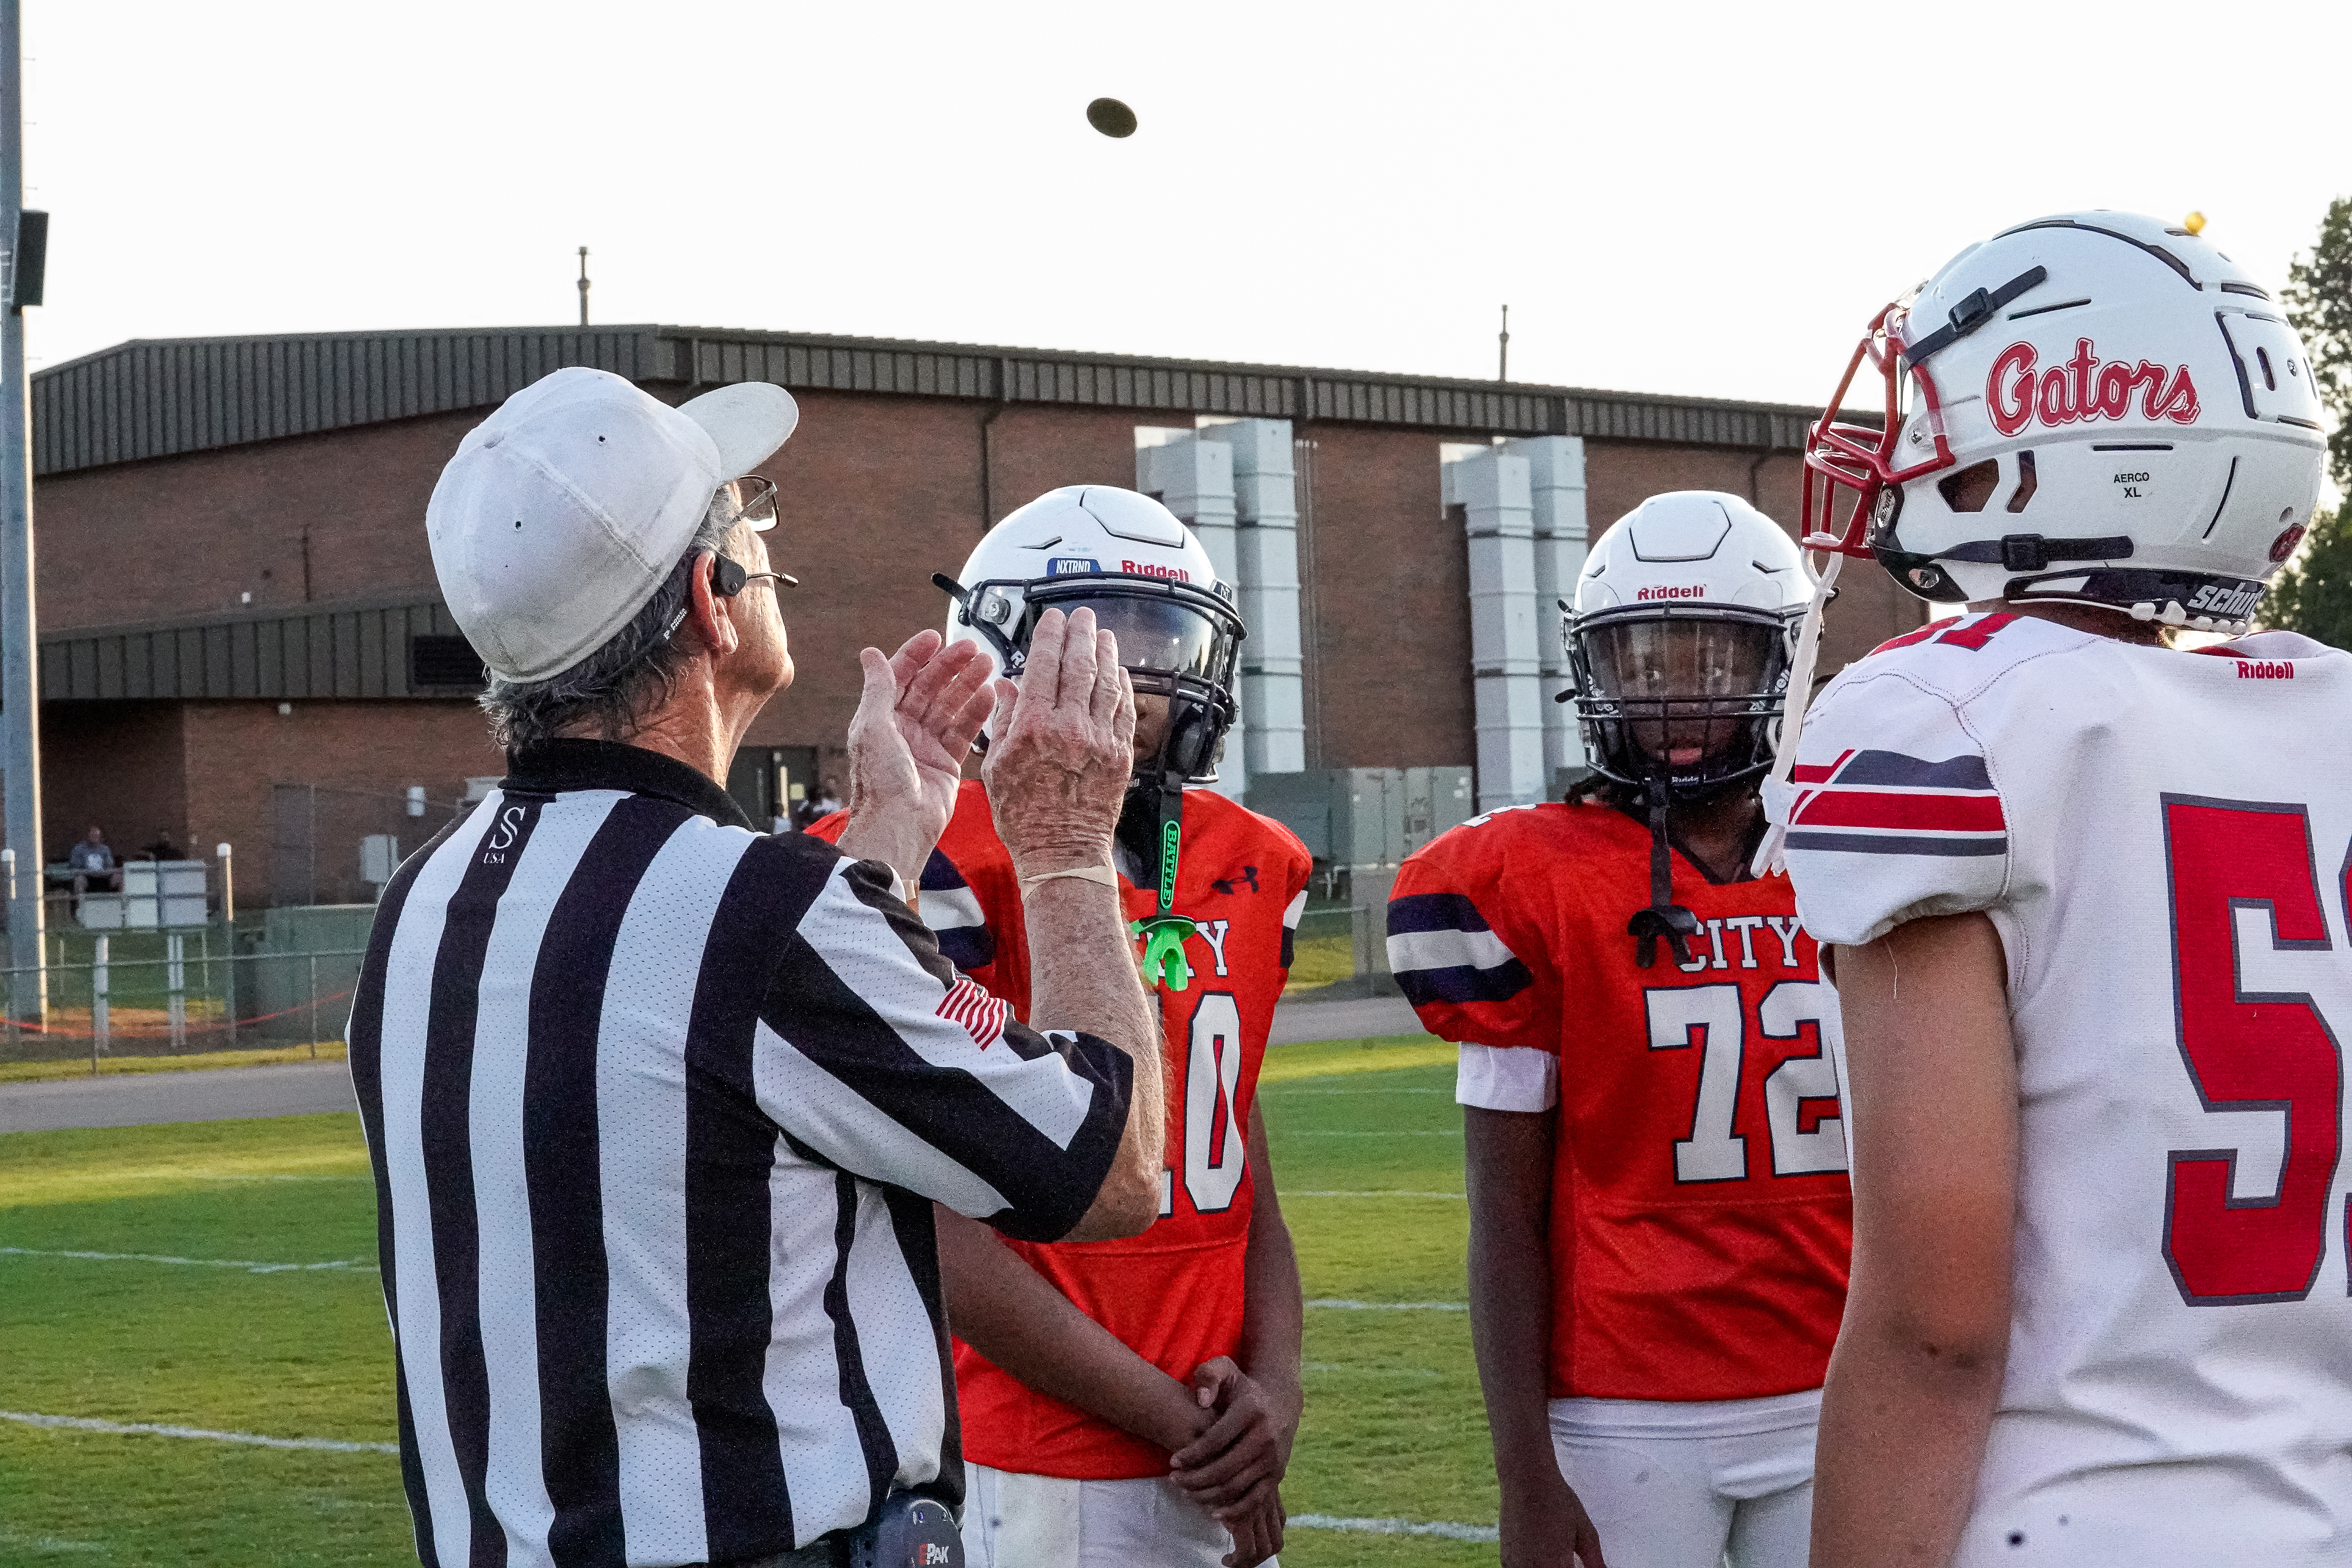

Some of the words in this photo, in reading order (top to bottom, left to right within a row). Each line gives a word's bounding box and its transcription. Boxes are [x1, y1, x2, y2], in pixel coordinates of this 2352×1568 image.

[1986, 338, 2201, 437] Gators
[2114, 472, 2150, 483] AERCO
[2123, 487, 2142, 498] XL
[1056, 560, 1091, 573] NXTRND
[1122, 560, 1189, 583] Riddell
[1638, 586, 1704, 600] Riddell
[2236, 661, 2294, 679] Riddell
[484, 853, 505, 864] USA
[1163, 829, 1177, 901] BATTLE
[2160, 791, 2352, 1307] 5
[1642, 980, 1849, 1185] 72
[1156, 991, 1245, 1218] 0
